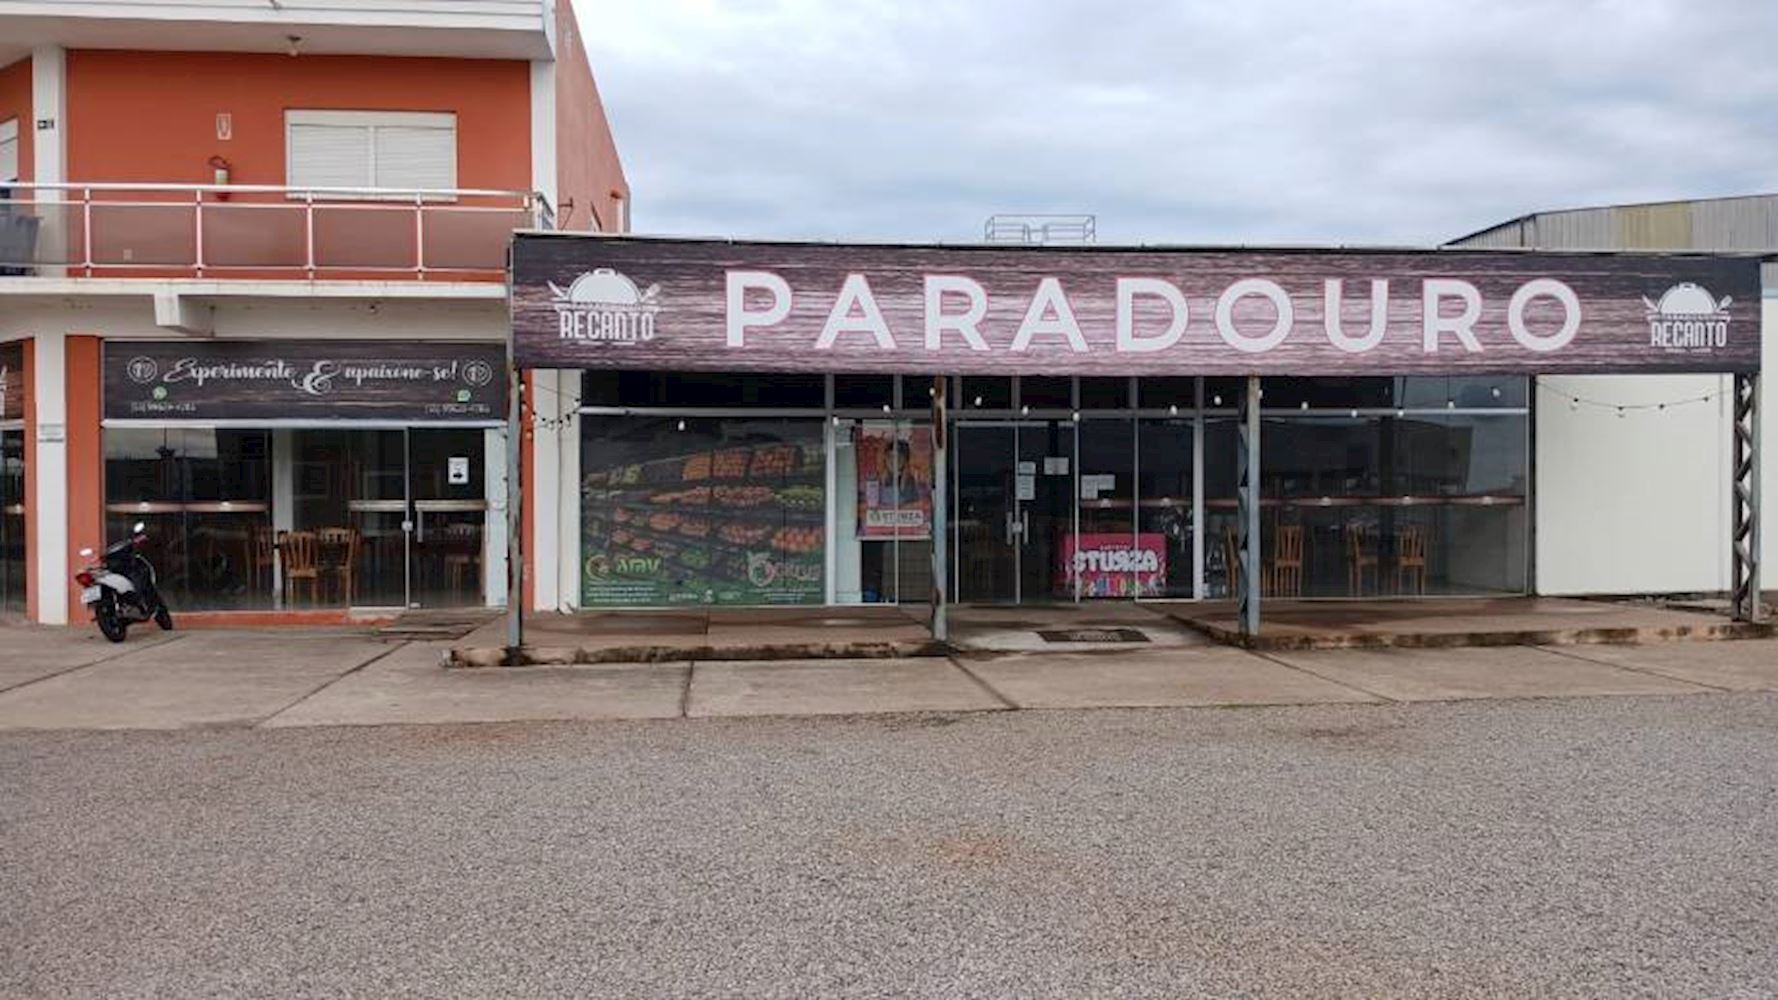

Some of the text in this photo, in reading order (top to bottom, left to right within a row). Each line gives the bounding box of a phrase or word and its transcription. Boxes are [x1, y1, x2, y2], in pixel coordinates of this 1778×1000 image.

[560, 310, 654, 340] RECANTO
[725, 270, 1582, 353] PARADOURO
[1651, 321, 1727, 347] RECANTO
[163, 357, 297, 387] Experimente
[344, 360, 457, 386] apaixone-se!
